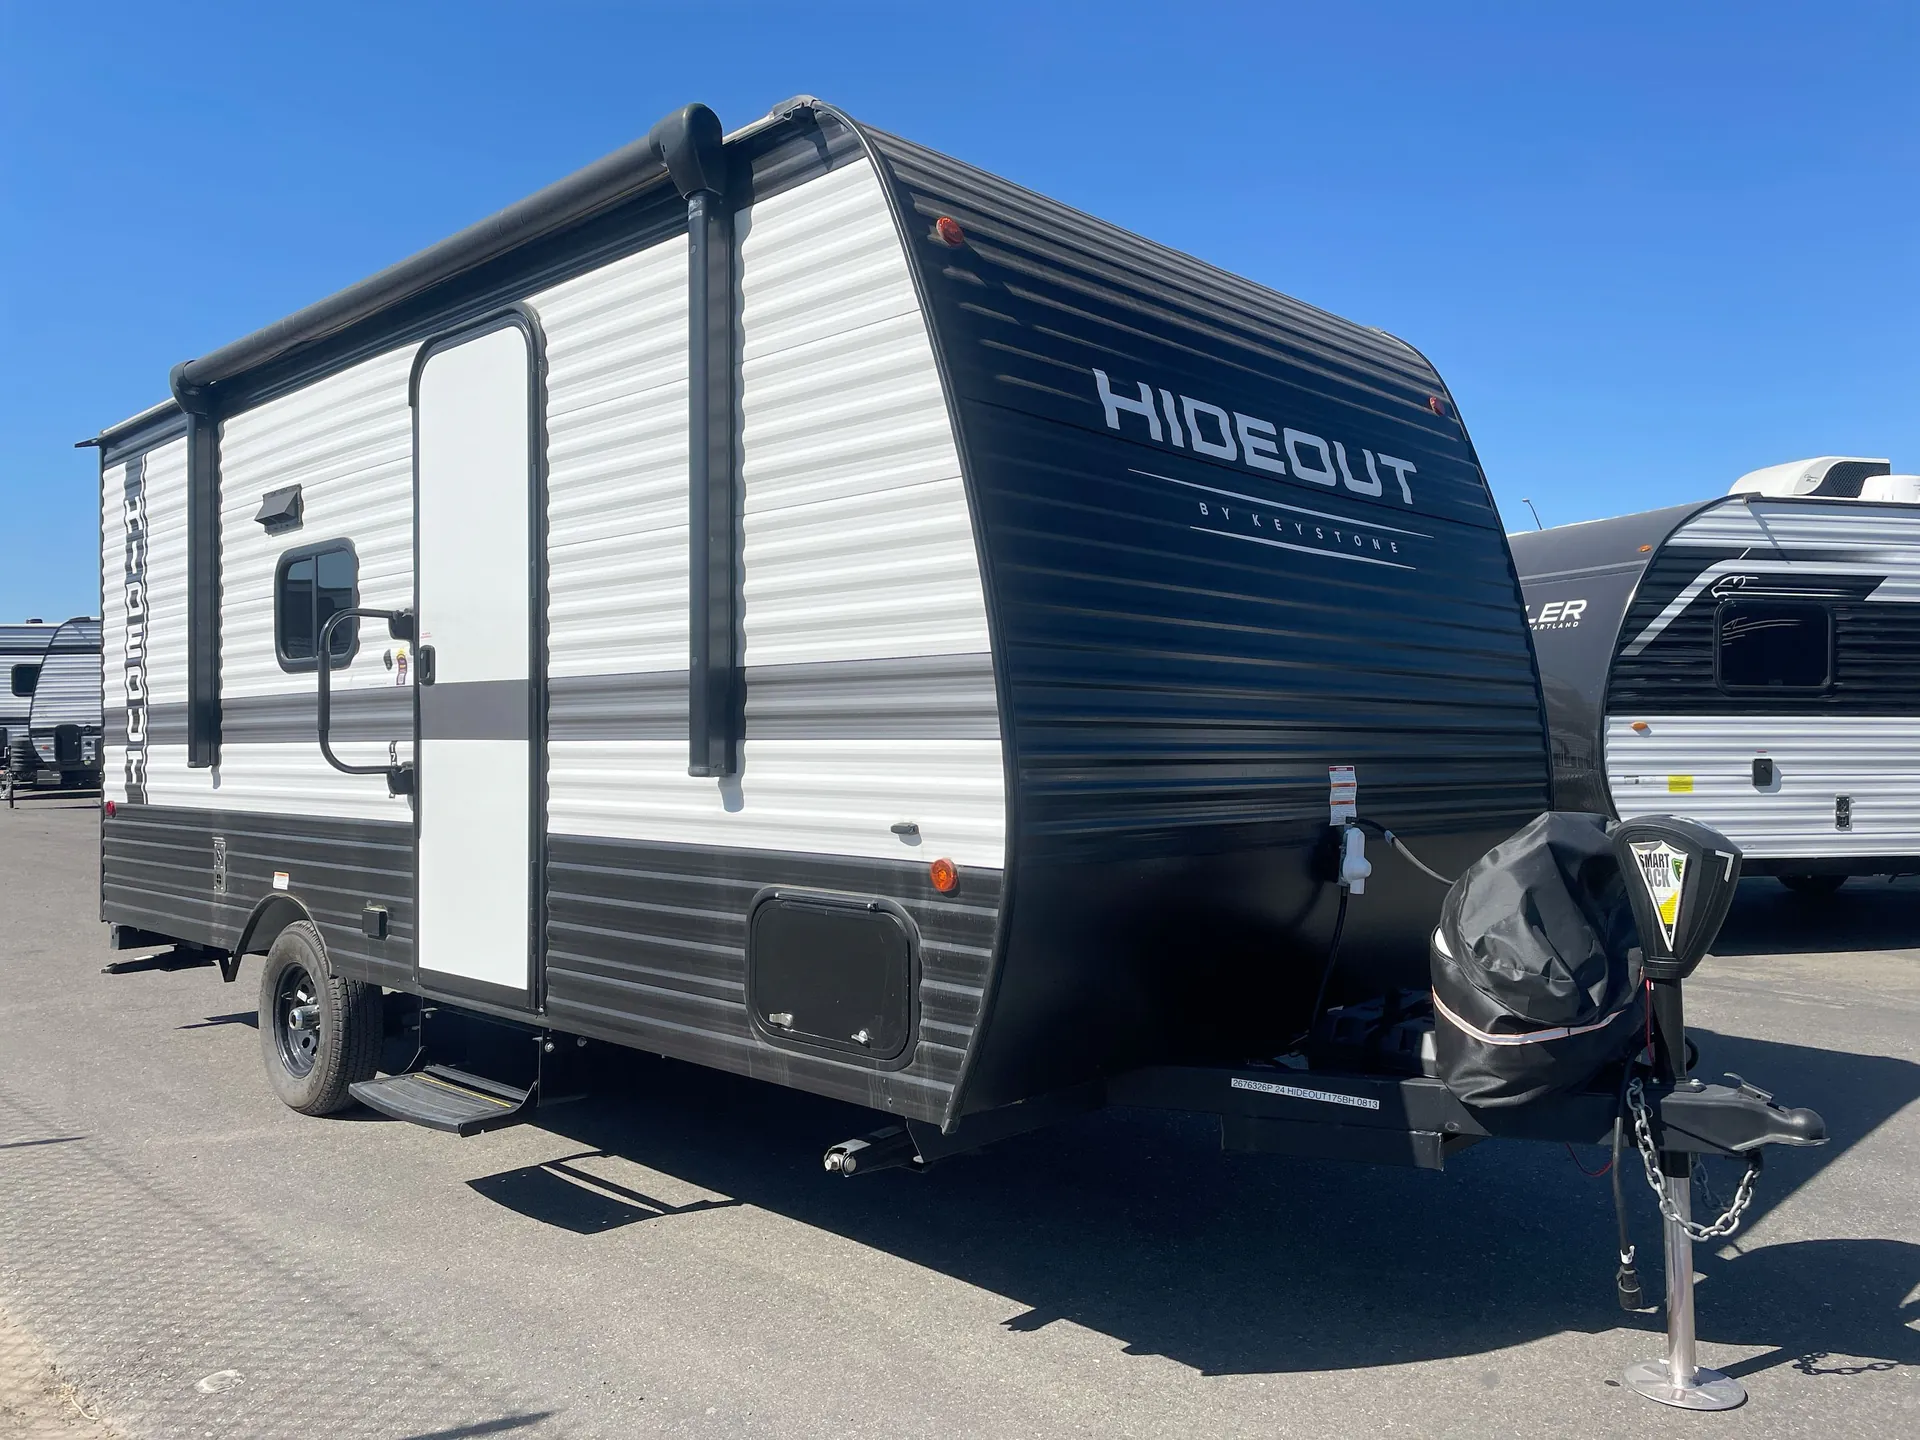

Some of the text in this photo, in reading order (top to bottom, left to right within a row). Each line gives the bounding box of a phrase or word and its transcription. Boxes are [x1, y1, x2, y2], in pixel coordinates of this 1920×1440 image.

[1092, 368, 1417, 504] HIDEOUT
[1200, 502, 1398, 553] BY KEYSTONE
[124, 496, 143, 784] HIDEOUT
[1529, 621, 1579, 631] ARTLAND
[1639, 853, 1669, 868] SMART
[1647, 868, 1670, 887] ACK
[1233, 1079, 1273, 1092] 2676326P
[1275, 1085, 1285, 1094] 24
[1357, 1099, 1378, 1109] 0813
